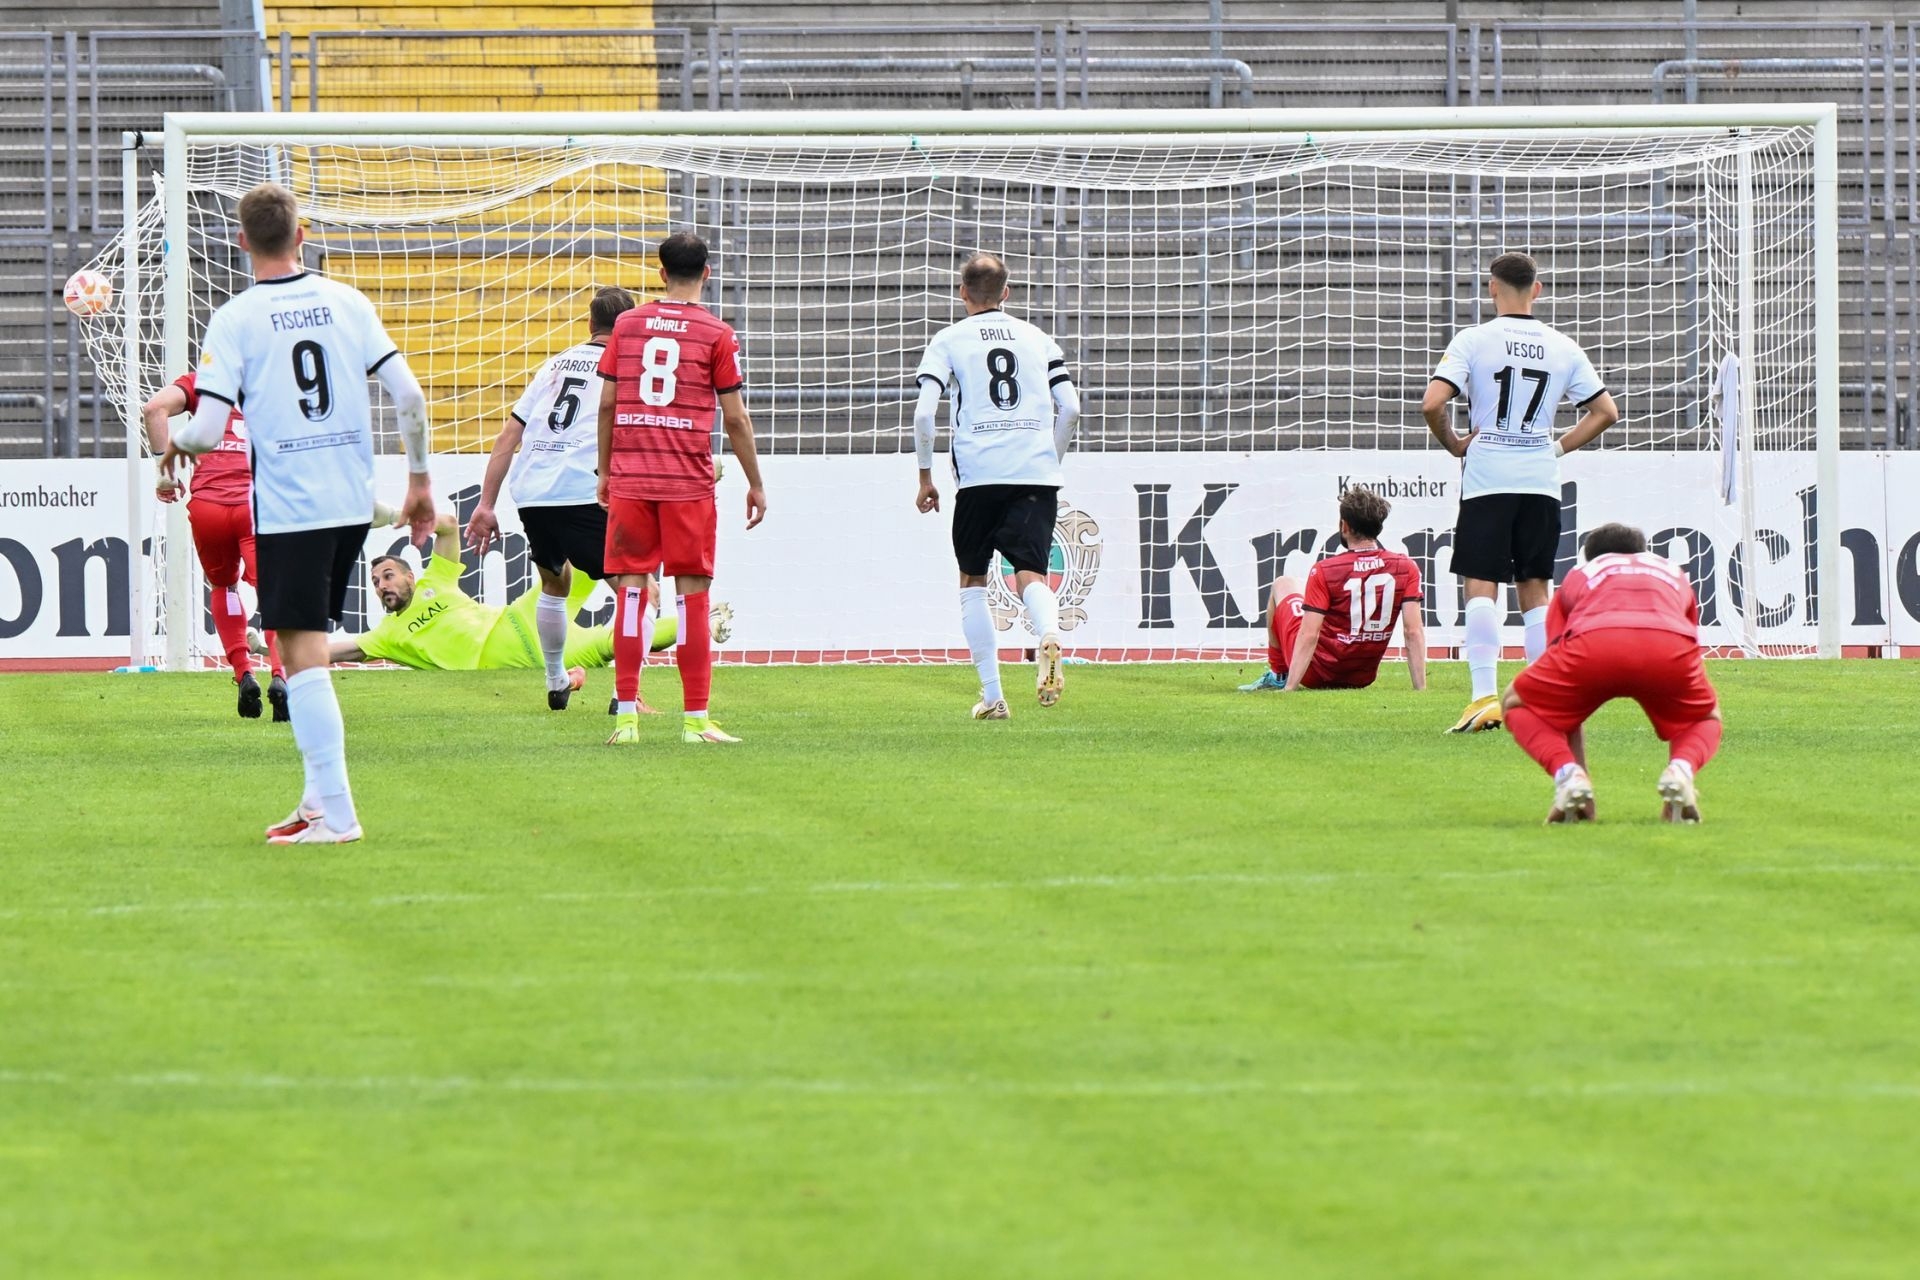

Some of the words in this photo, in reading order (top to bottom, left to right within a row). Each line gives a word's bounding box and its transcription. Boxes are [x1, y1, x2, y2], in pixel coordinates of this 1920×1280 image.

[270, 307, 333, 332] FISCHER
[645, 317, 690, 333] WÖHRLE
[980, 328, 1016, 341] BRILL
[1505, 341, 1544, 360] VESCO
[292, 340, 334, 422] 9
[639, 336, 680, 407] 8
[987, 347, 1021, 411] 8
[548, 377, 588, 434] 5
[1494, 365, 1551, 433] 17
[617, 414, 693, 430] BIZERBA
[0, 484, 98, 507] rombacher
[1343, 572, 1396, 636] 10
